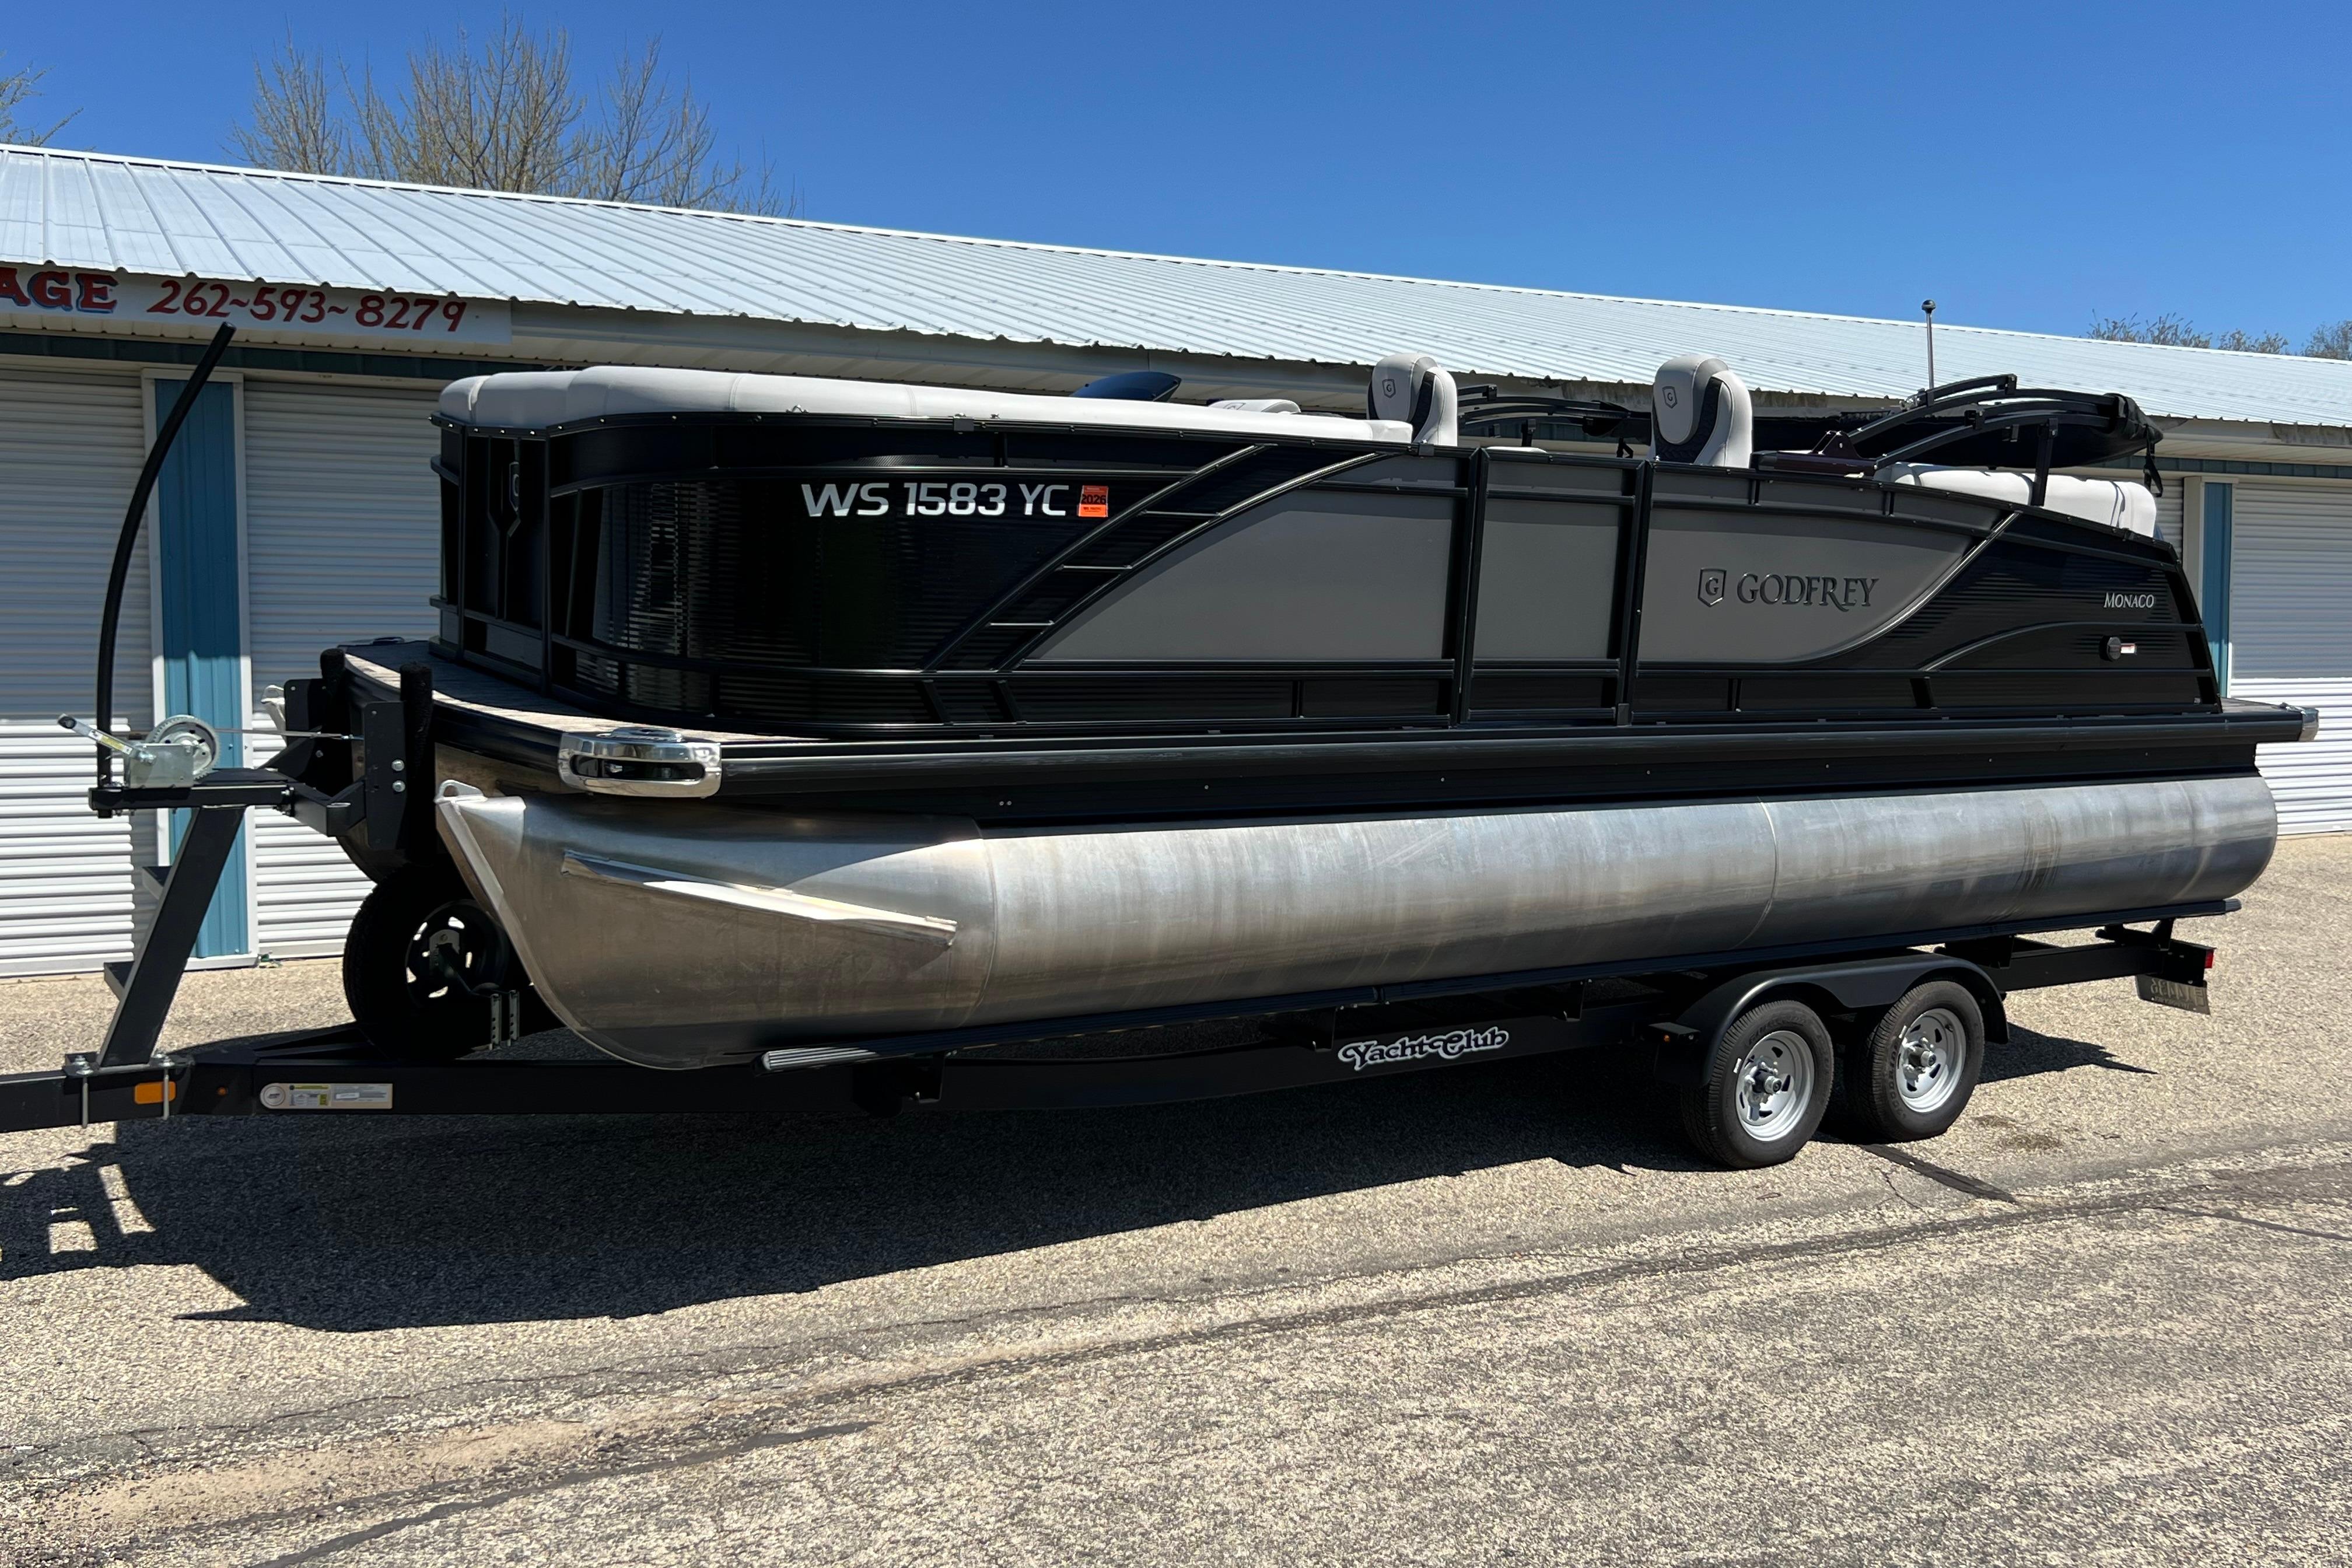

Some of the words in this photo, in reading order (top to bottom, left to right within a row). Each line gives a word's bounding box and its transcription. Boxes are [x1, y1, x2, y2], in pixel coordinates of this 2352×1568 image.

[801, 482, 889, 517] WS
[904, 482, 1007, 516] 1583
[1019, 484, 1069, 516] YC
[1081, 494, 1107, 505] 2026
[1705, 576, 1719, 596] G
[1737, 572, 1880, 612] GODFREY
[2103, 592, 2155, 608] MONACO
